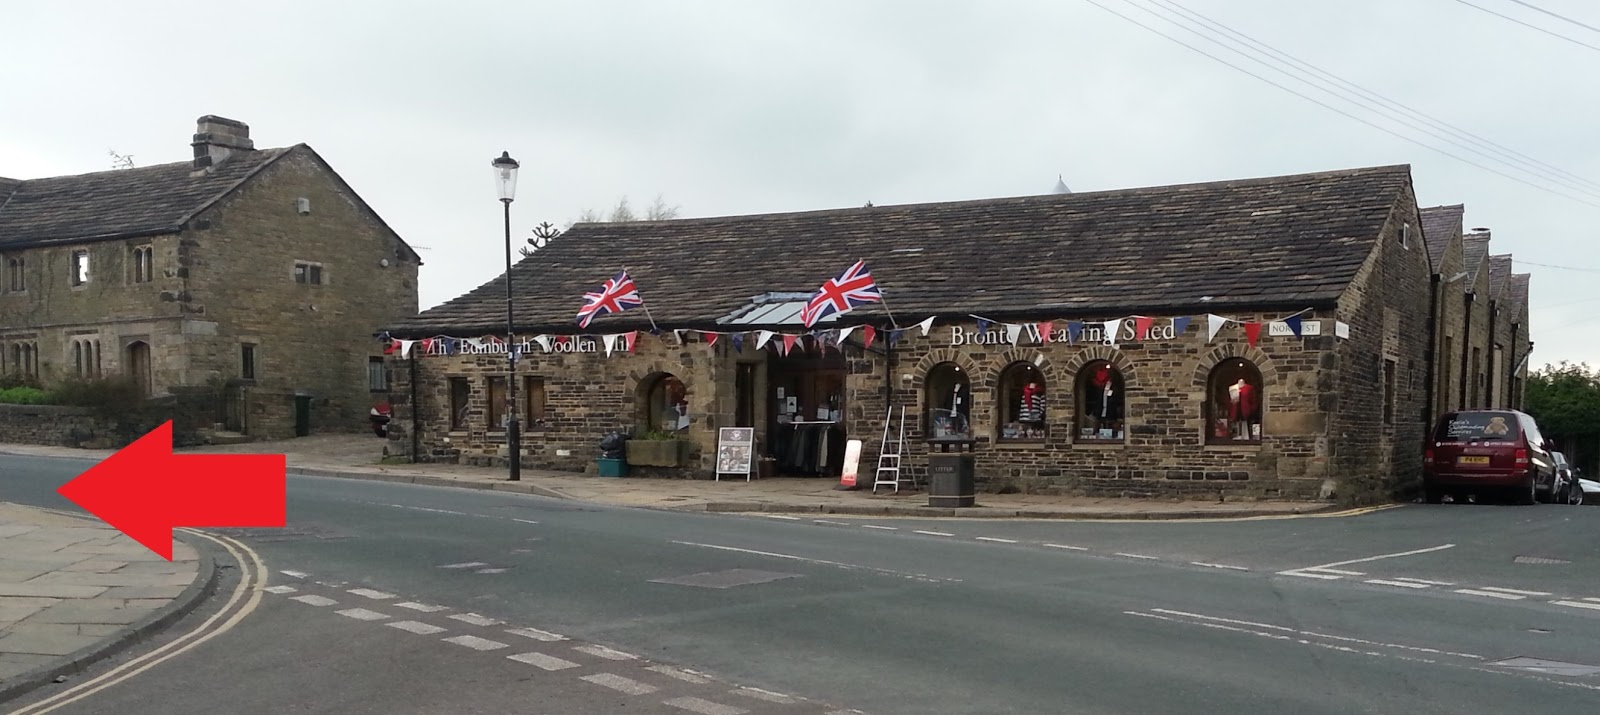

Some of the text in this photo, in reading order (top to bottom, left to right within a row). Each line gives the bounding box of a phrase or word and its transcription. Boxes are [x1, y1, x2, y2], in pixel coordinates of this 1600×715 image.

[1024, 322, 1117, 348] Weaing
[1272, 324, 1316, 333] NOR ST
[429, 338, 453, 355] Th
